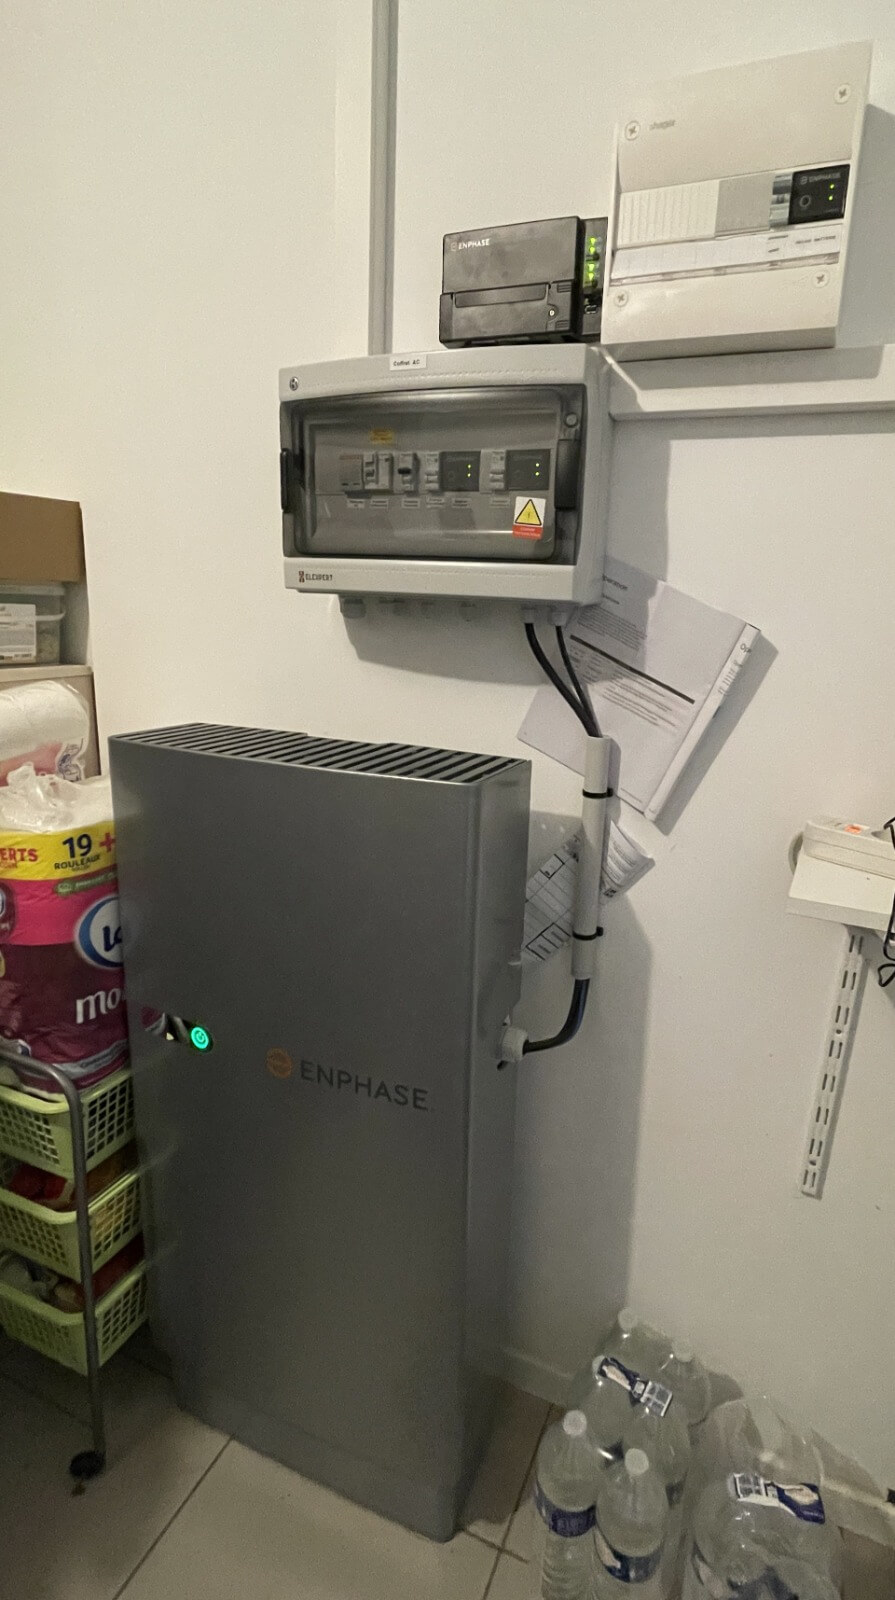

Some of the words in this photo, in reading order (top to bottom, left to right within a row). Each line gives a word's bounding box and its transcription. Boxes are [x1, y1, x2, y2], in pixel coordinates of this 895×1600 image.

[458, 238, 490, 250] ENPHASE
[62, 833, 93, 859] 19
[54, 854, 101, 870] ROULEAUX
[76, 987, 122, 1025] mo
[300, 1059, 430, 1112] ENPHASE
